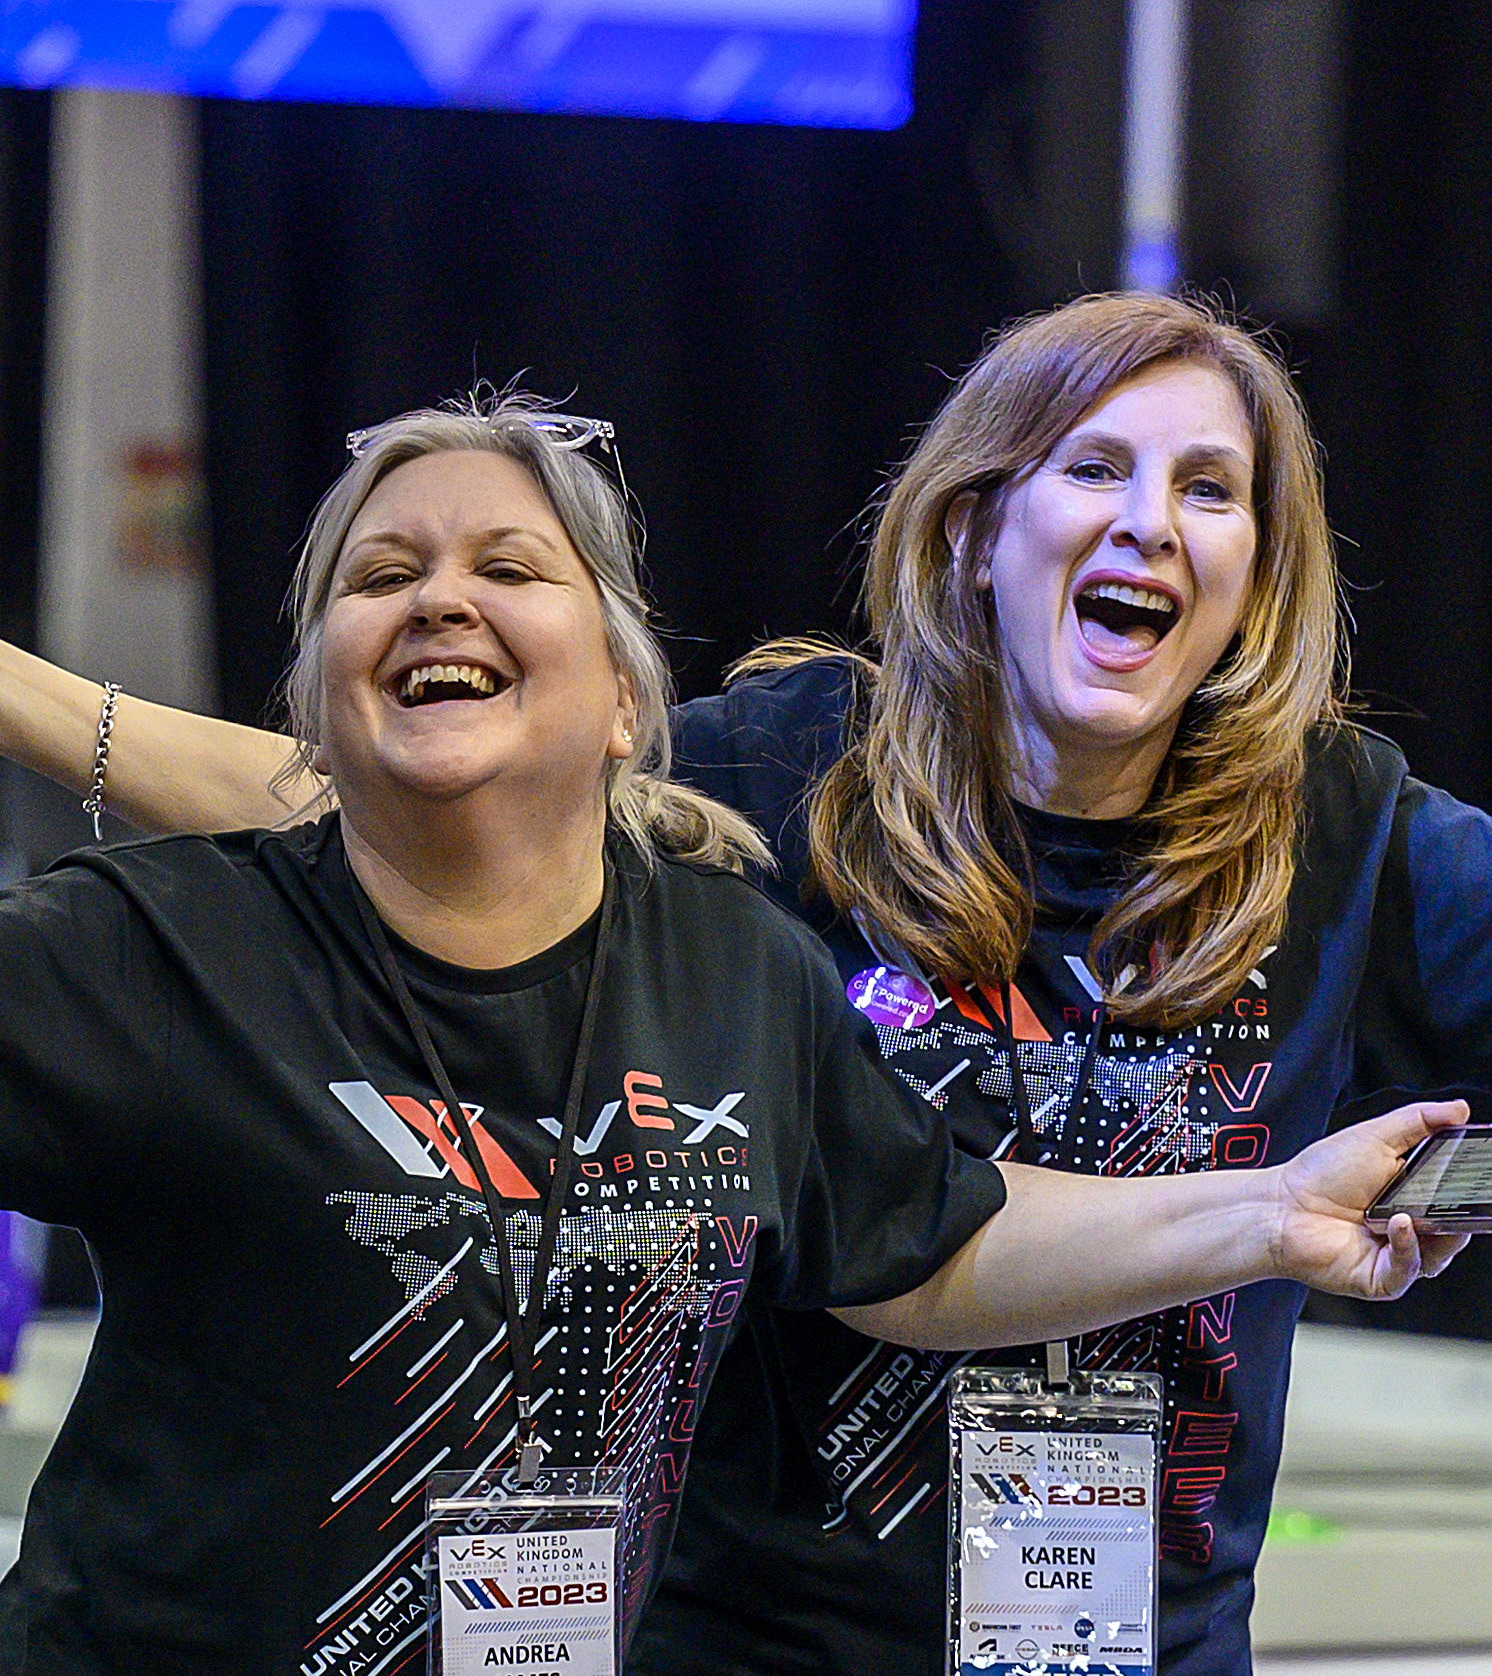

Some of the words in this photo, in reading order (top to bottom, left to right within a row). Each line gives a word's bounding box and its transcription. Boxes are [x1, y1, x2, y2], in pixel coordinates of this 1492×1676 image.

[1063, 1023, 1270, 1049] CMPEITION
[537, 1070, 750, 1156] VEX
[574, 1174, 750, 1198] OMPETITION
[1159, 1062, 1271, 1562] VONTEER
[817, 1352, 914, 1461] UNITED
[976, 1436, 1036, 1456] VEX
[1047, 1437, 1103, 1448] UNITED
[825, 1428, 890, 1515] NIONAL
[1047, 1464, 1146, 1475] NATIONAL
[1047, 1485, 1147, 1506] 2023
[449, 1539, 507, 1562] VEX
[516, 1535, 568, 1548] UNITED
[516, 1548, 583, 1562] KINGDOM
[1021, 1546, 1095, 1565] KAREN
[517, 1562, 607, 1575] NATIONAL
[517, 1573, 608, 1585] CHAMPIONSHIP
[1024, 1571, 1093, 1590] CLARE
[517, 1582, 608, 1608] 2023
[484, 1643, 570, 1667] ANDREA
